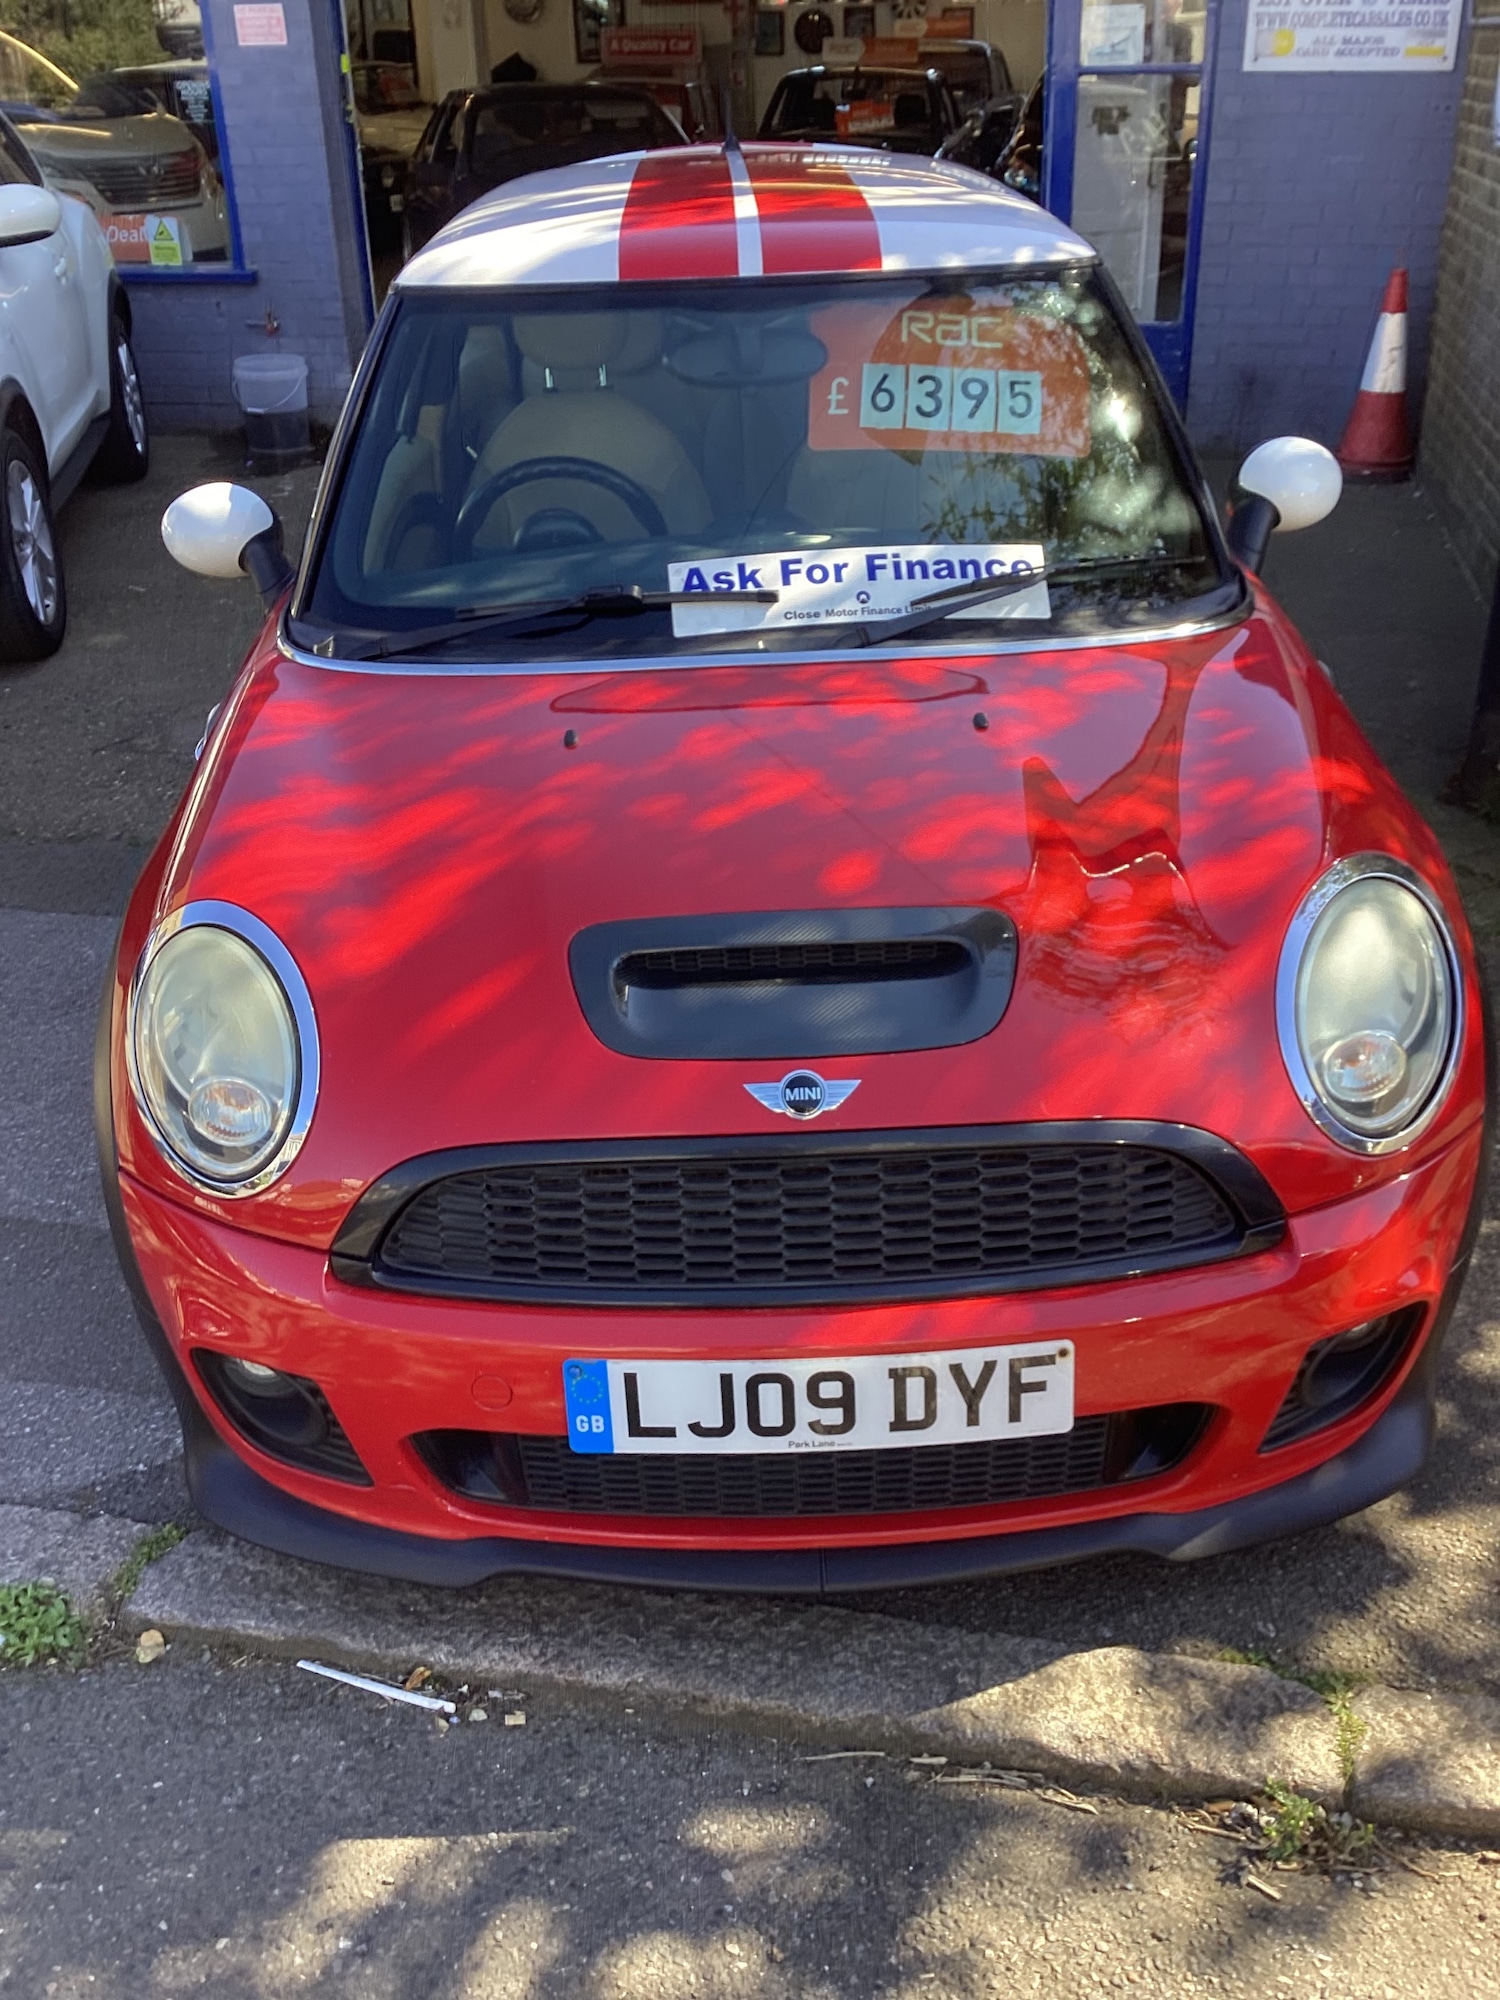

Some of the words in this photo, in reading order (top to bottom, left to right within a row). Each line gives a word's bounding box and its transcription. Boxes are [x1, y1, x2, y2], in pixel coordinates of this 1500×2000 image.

[682, 562, 765, 592] Ask
[779, 557, 849, 585] For
[865, 552, 1034, 581] Finance
[783, 610, 821, 621] Close
[825, 608, 859, 618] Motor
[861, 605, 903, 616] Finance
[785, 1086, 821, 1102] MINI
[623, 1370, 856, 1438] LJ09
[888, 1353, 1057, 1431] DYF
[575, 1414, 605, 1434] GB
[788, 1440, 811, 1449] Park
[812, 1440, 835, 1448] Lane
